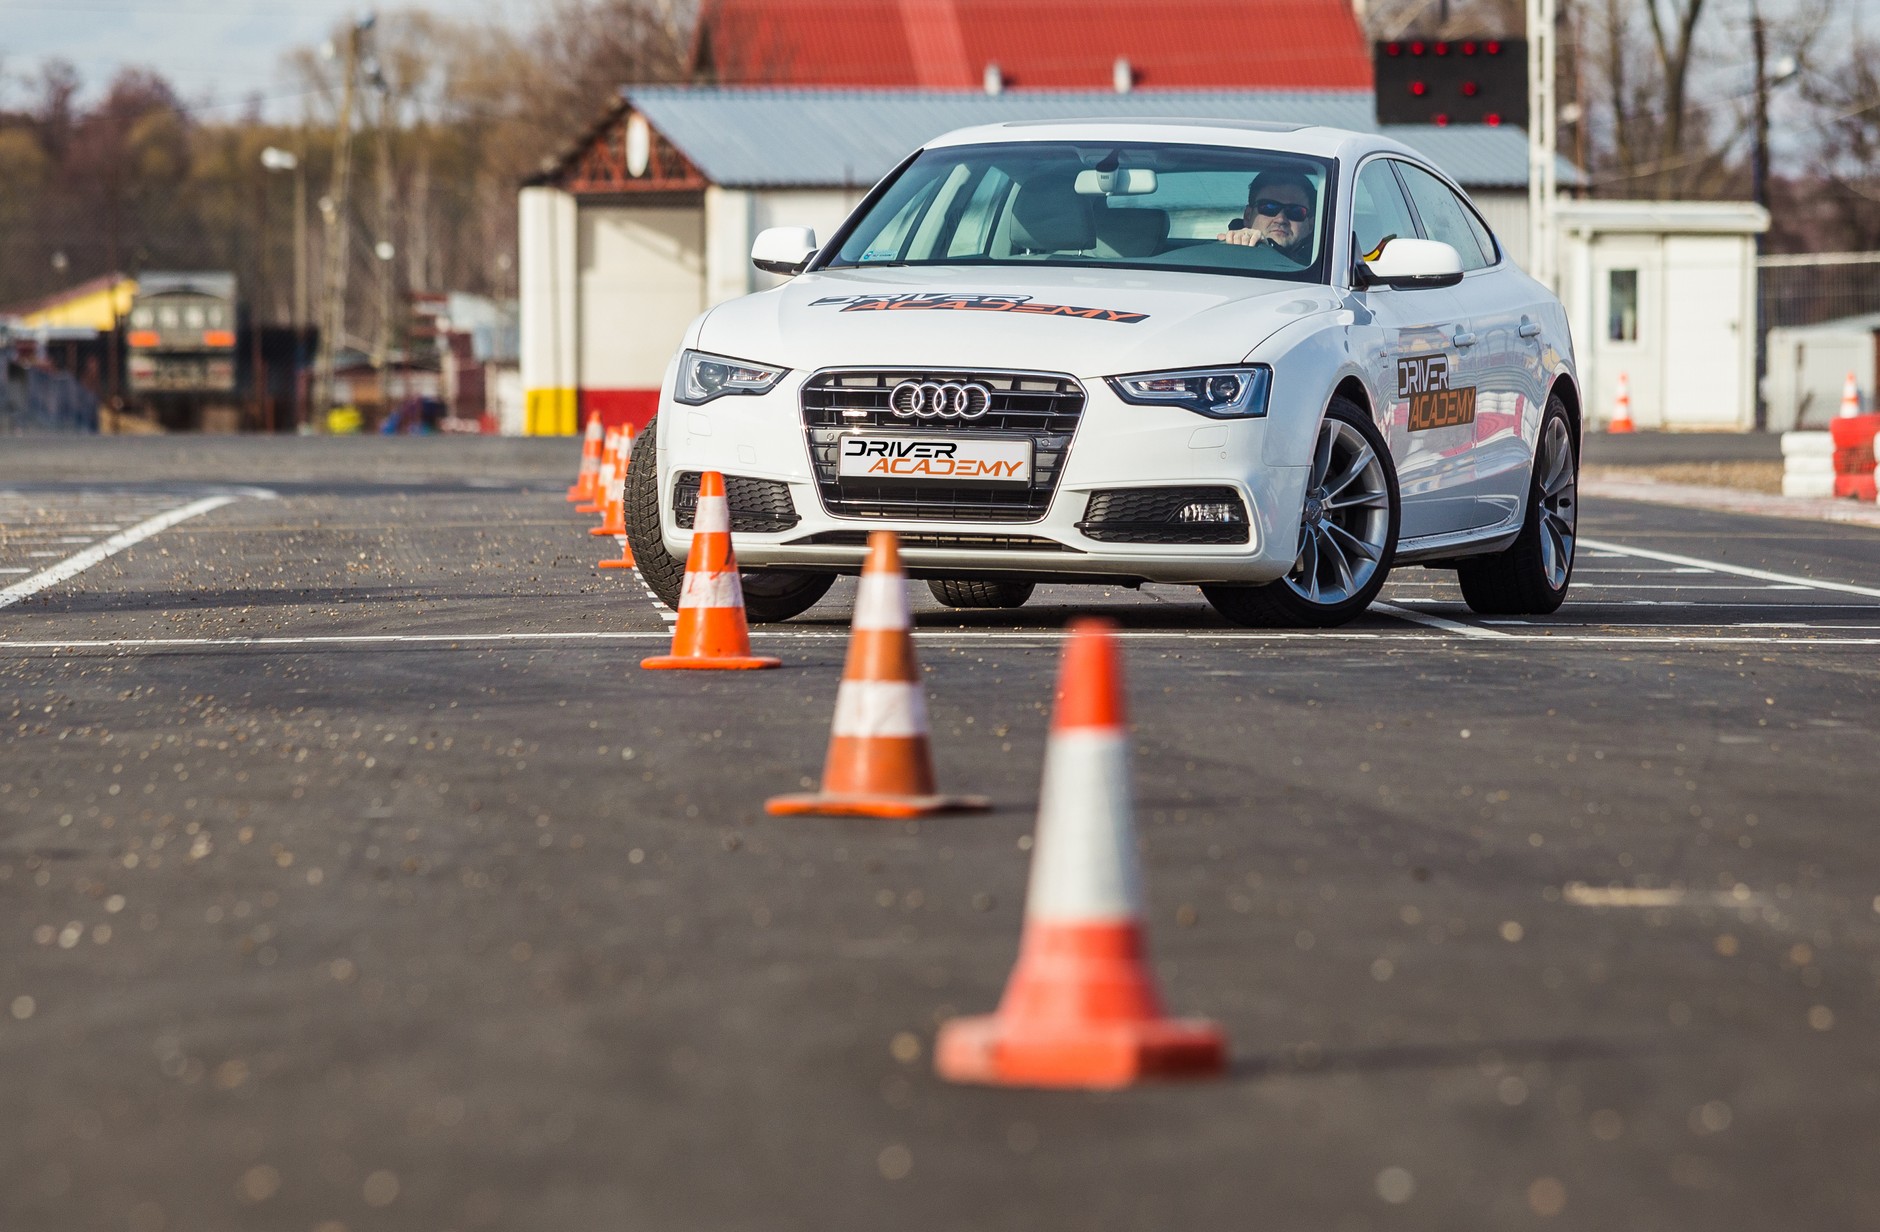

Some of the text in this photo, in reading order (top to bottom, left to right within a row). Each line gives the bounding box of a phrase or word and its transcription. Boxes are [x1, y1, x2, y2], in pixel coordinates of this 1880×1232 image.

[811, 293, 1031, 305] DRIVER
[848, 301, 1144, 321] ACADEMY
[1399, 357, 1448, 395] DRIVER
[1409, 388, 1475, 430] ACADEMY
[845, 441, 957, 458] DRIVER
[868, 458, 1023, 477] ACADEMY
